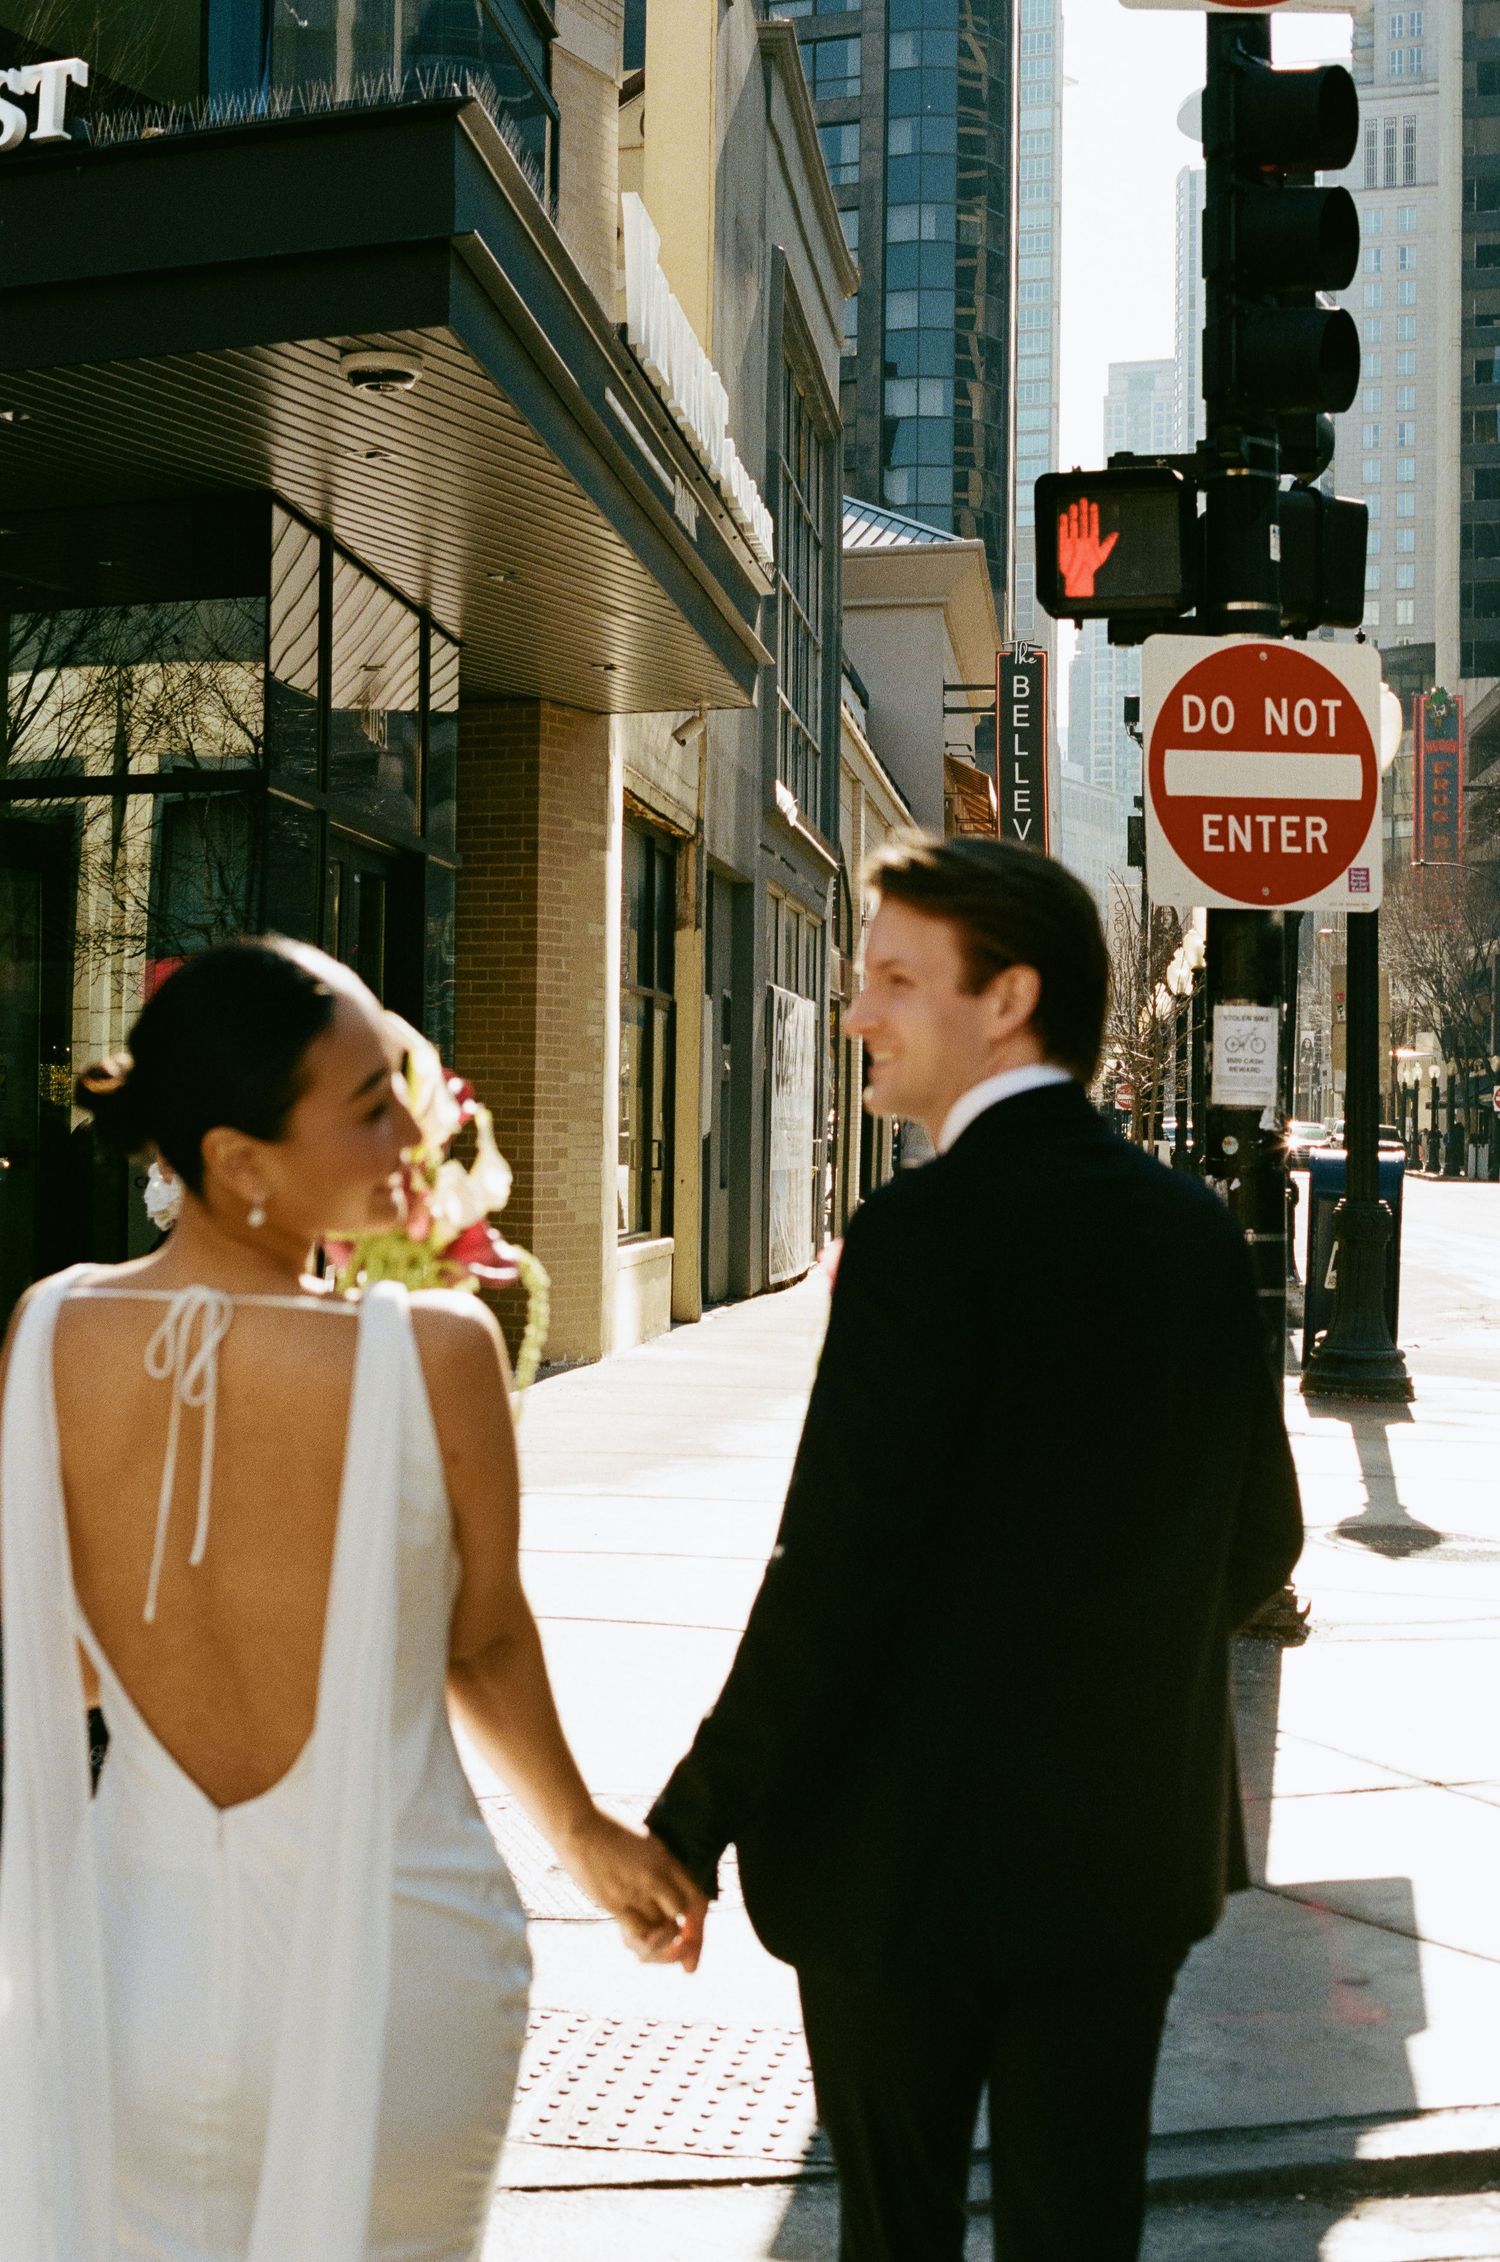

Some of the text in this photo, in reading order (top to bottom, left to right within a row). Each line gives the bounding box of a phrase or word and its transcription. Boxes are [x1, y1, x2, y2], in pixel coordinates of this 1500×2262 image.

[1002, 638, 1037, 665] The
[1181, 694, 1342, 738] DO NOT
[1201, 813, 1329, 854] ENTER
